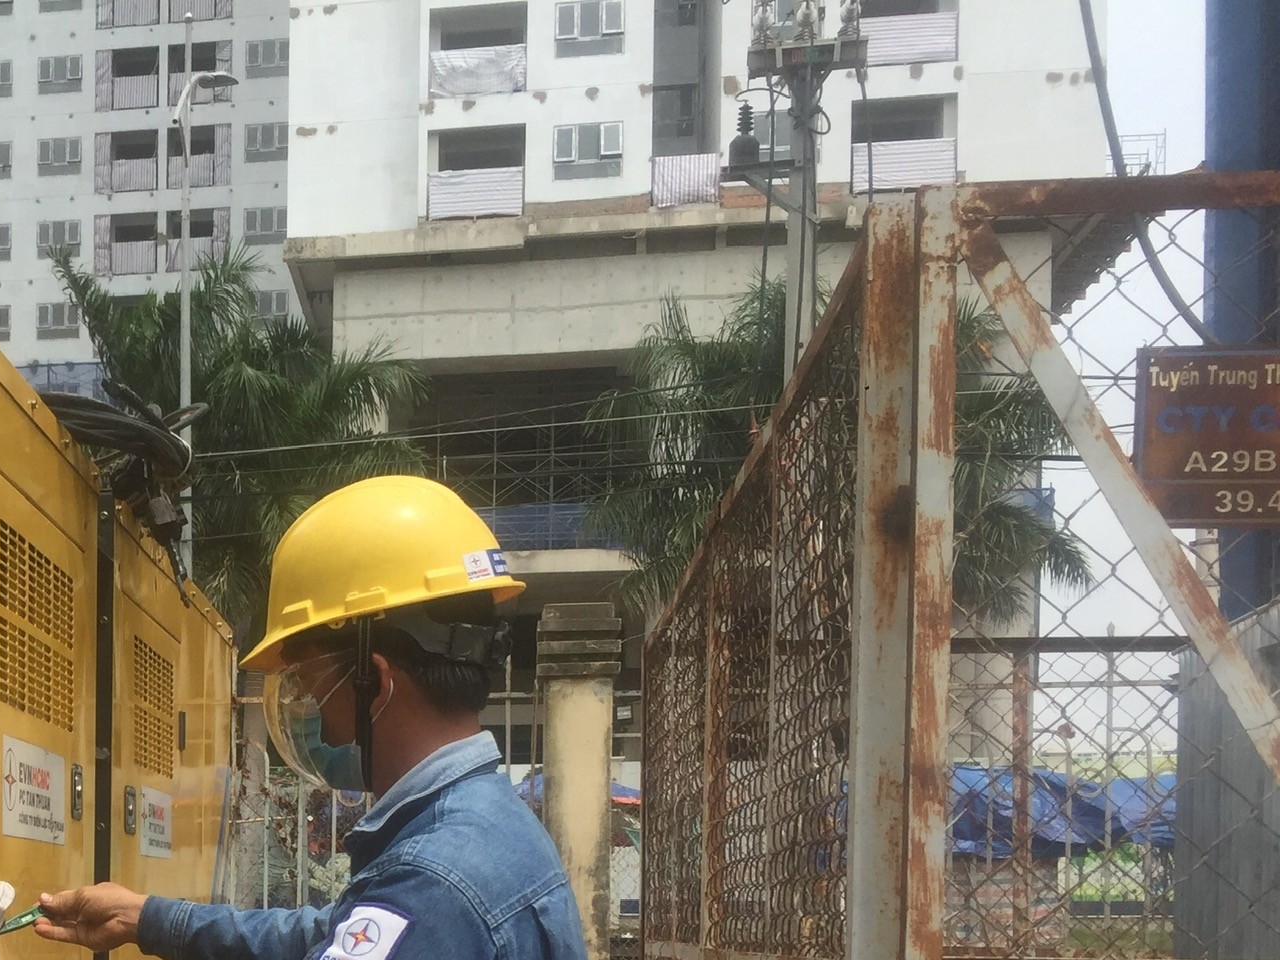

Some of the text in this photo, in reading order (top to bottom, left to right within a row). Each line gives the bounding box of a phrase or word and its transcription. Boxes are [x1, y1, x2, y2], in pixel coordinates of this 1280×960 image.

[1149, 361, 1200, 392] Tuyến
[1207, 364, 1258, 390] Trung
[1157, 405, 1237, 434] CTY
[1183, 450, 1277, 473] A29B
[19, 762, 50, 791] EVNHCMC
